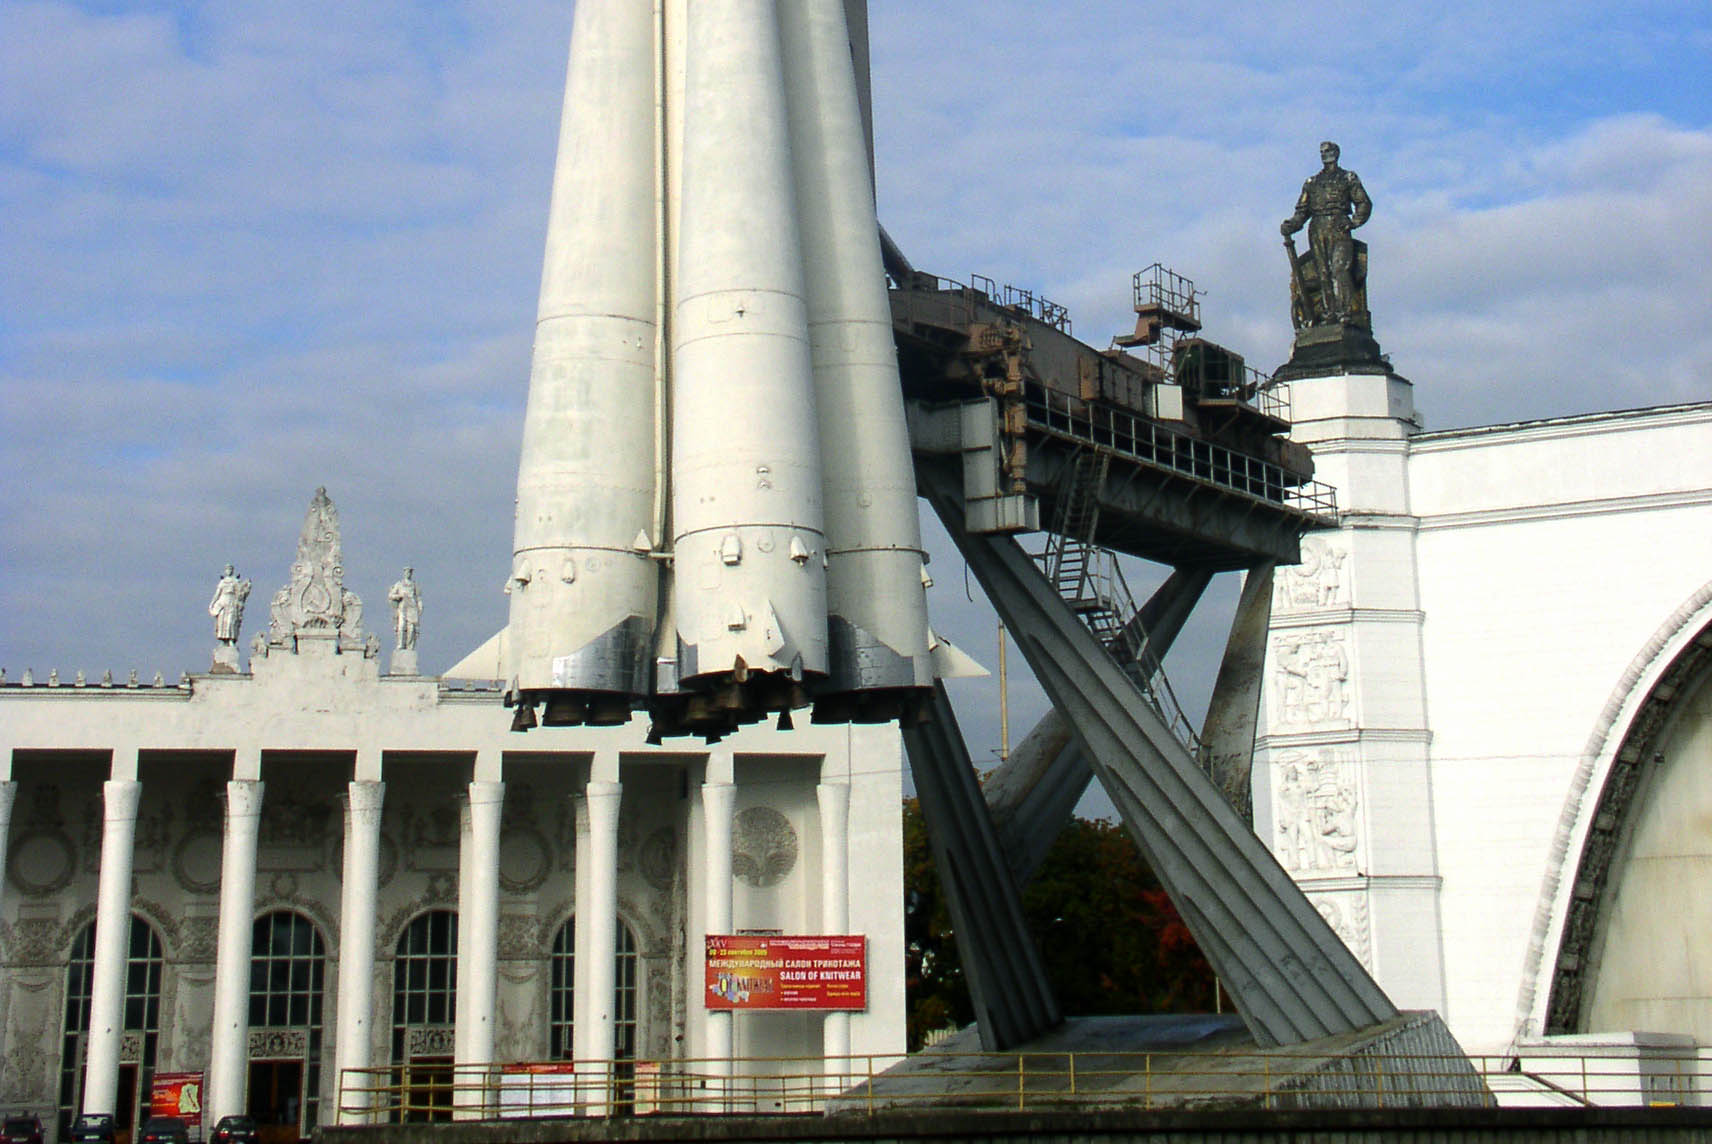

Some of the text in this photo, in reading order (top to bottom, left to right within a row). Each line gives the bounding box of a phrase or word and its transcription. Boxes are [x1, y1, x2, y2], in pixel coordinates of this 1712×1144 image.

[709, 959, 861, 969] МЕЖДУНАРОДНЫЙ САЛОН ТРИКОТАЖА
[780, 971, 861, 981] SALON OF KNITWEAR
